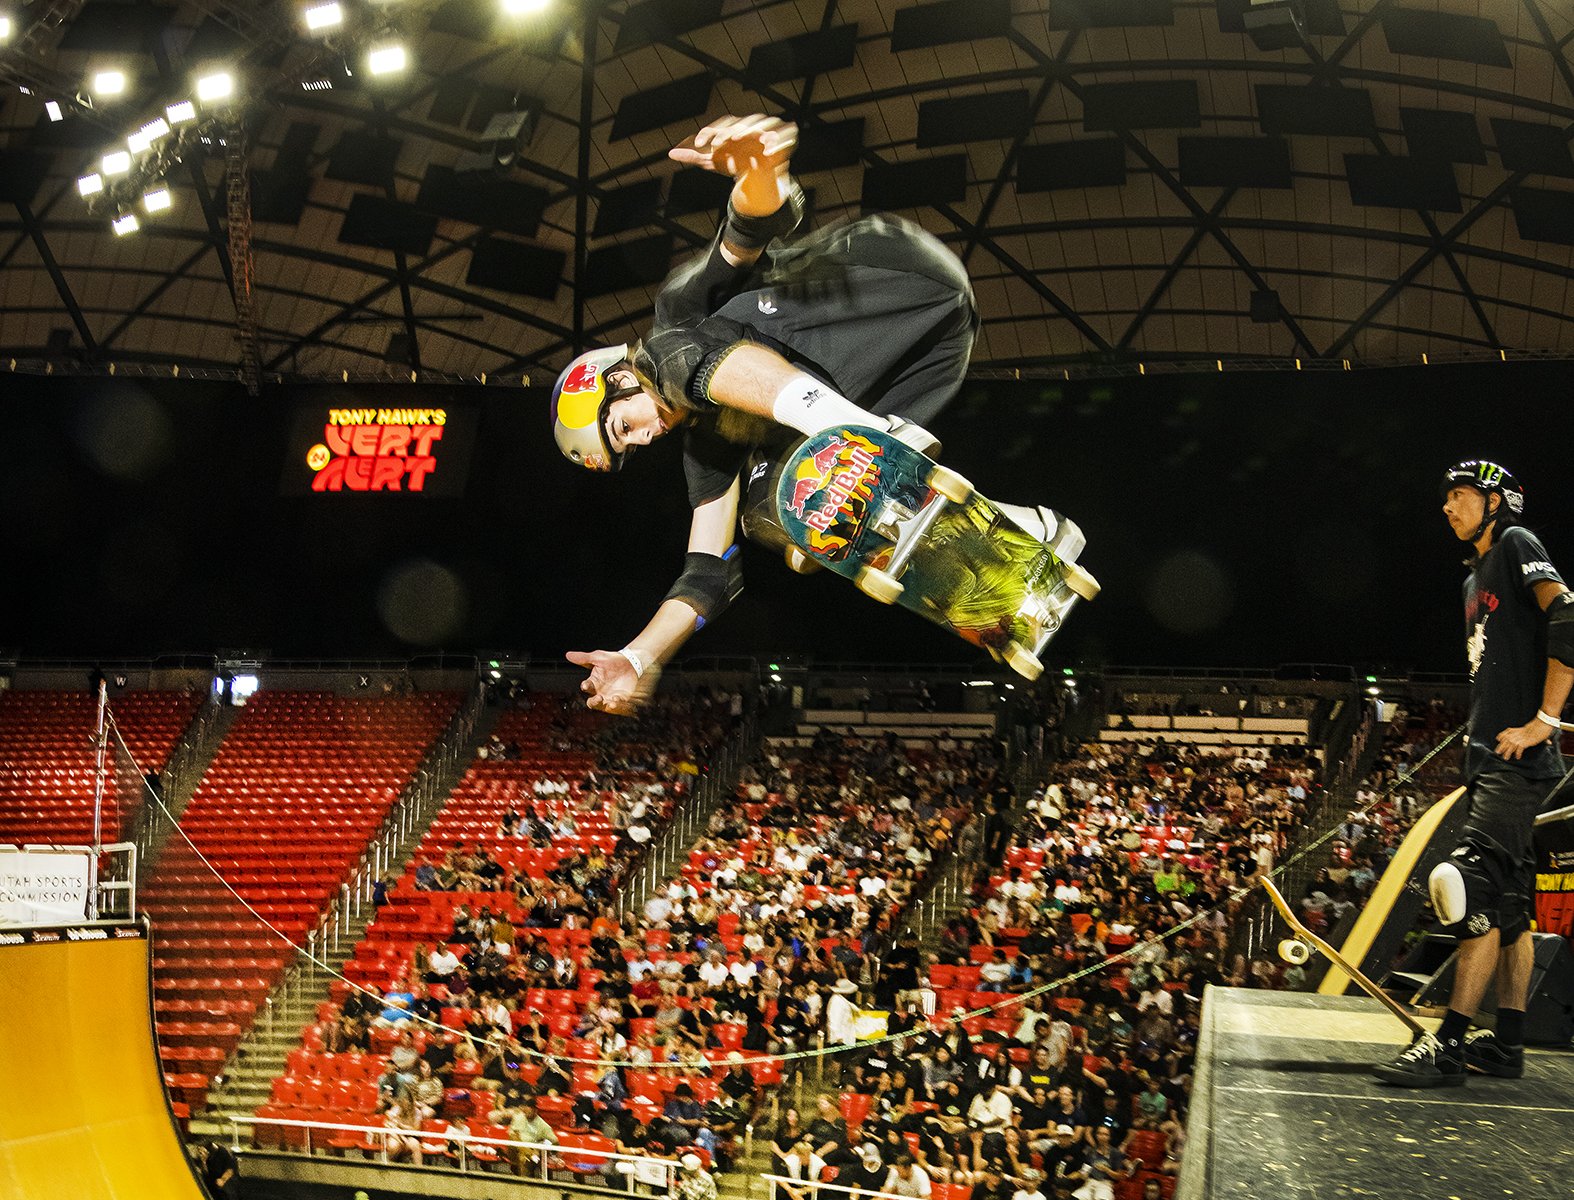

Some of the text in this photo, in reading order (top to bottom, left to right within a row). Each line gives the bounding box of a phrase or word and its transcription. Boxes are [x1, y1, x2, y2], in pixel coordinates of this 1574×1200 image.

[329, 408, 447, 426] TONY HAWK'S
[325, 423, 444, 457] VERT
[806, 485, 849, 533] Red
[833, 446, 874, 493] Bull
[115, 675, 127, 687] W
[359, 675, 369, 687] X
[0, 876, 82, 888] UTAH SPORTS
[0, 892, 80, 903] COMMISSION
